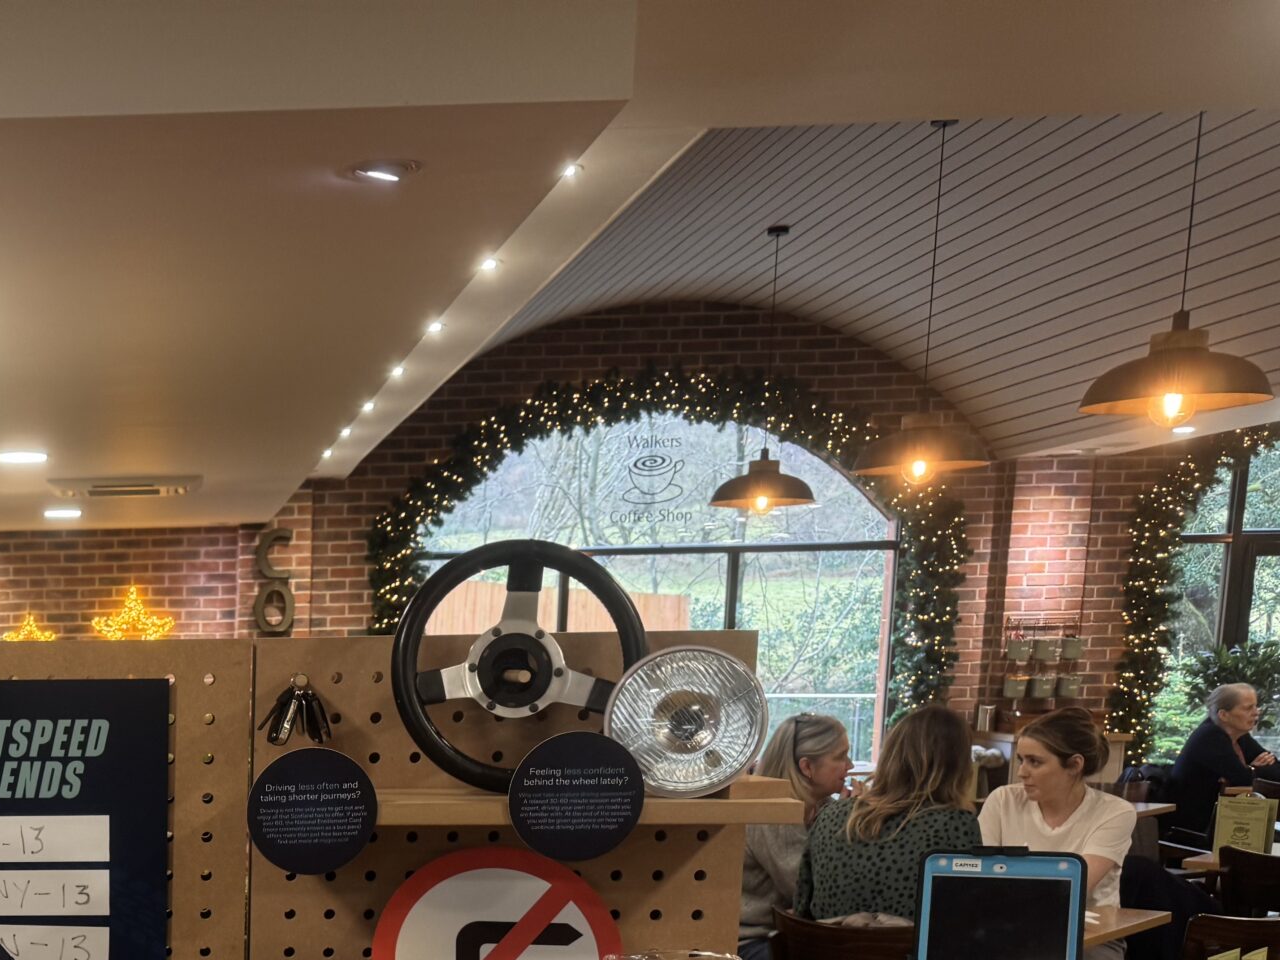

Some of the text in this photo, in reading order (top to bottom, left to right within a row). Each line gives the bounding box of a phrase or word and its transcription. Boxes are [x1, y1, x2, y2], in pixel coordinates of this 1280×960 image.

[628, 435, 682, 449] Walkers
[610, 509, 692, 524] Coffee Shop
[529, 767, 561, 777] Feeling
[583, 767, 625, 775] confident
[265, 781, 358, 793] Driving less often and
[524, 776, 629, 787] behind the wheel lately?
[260, 791, 360, 804] taking shorter journeys?
